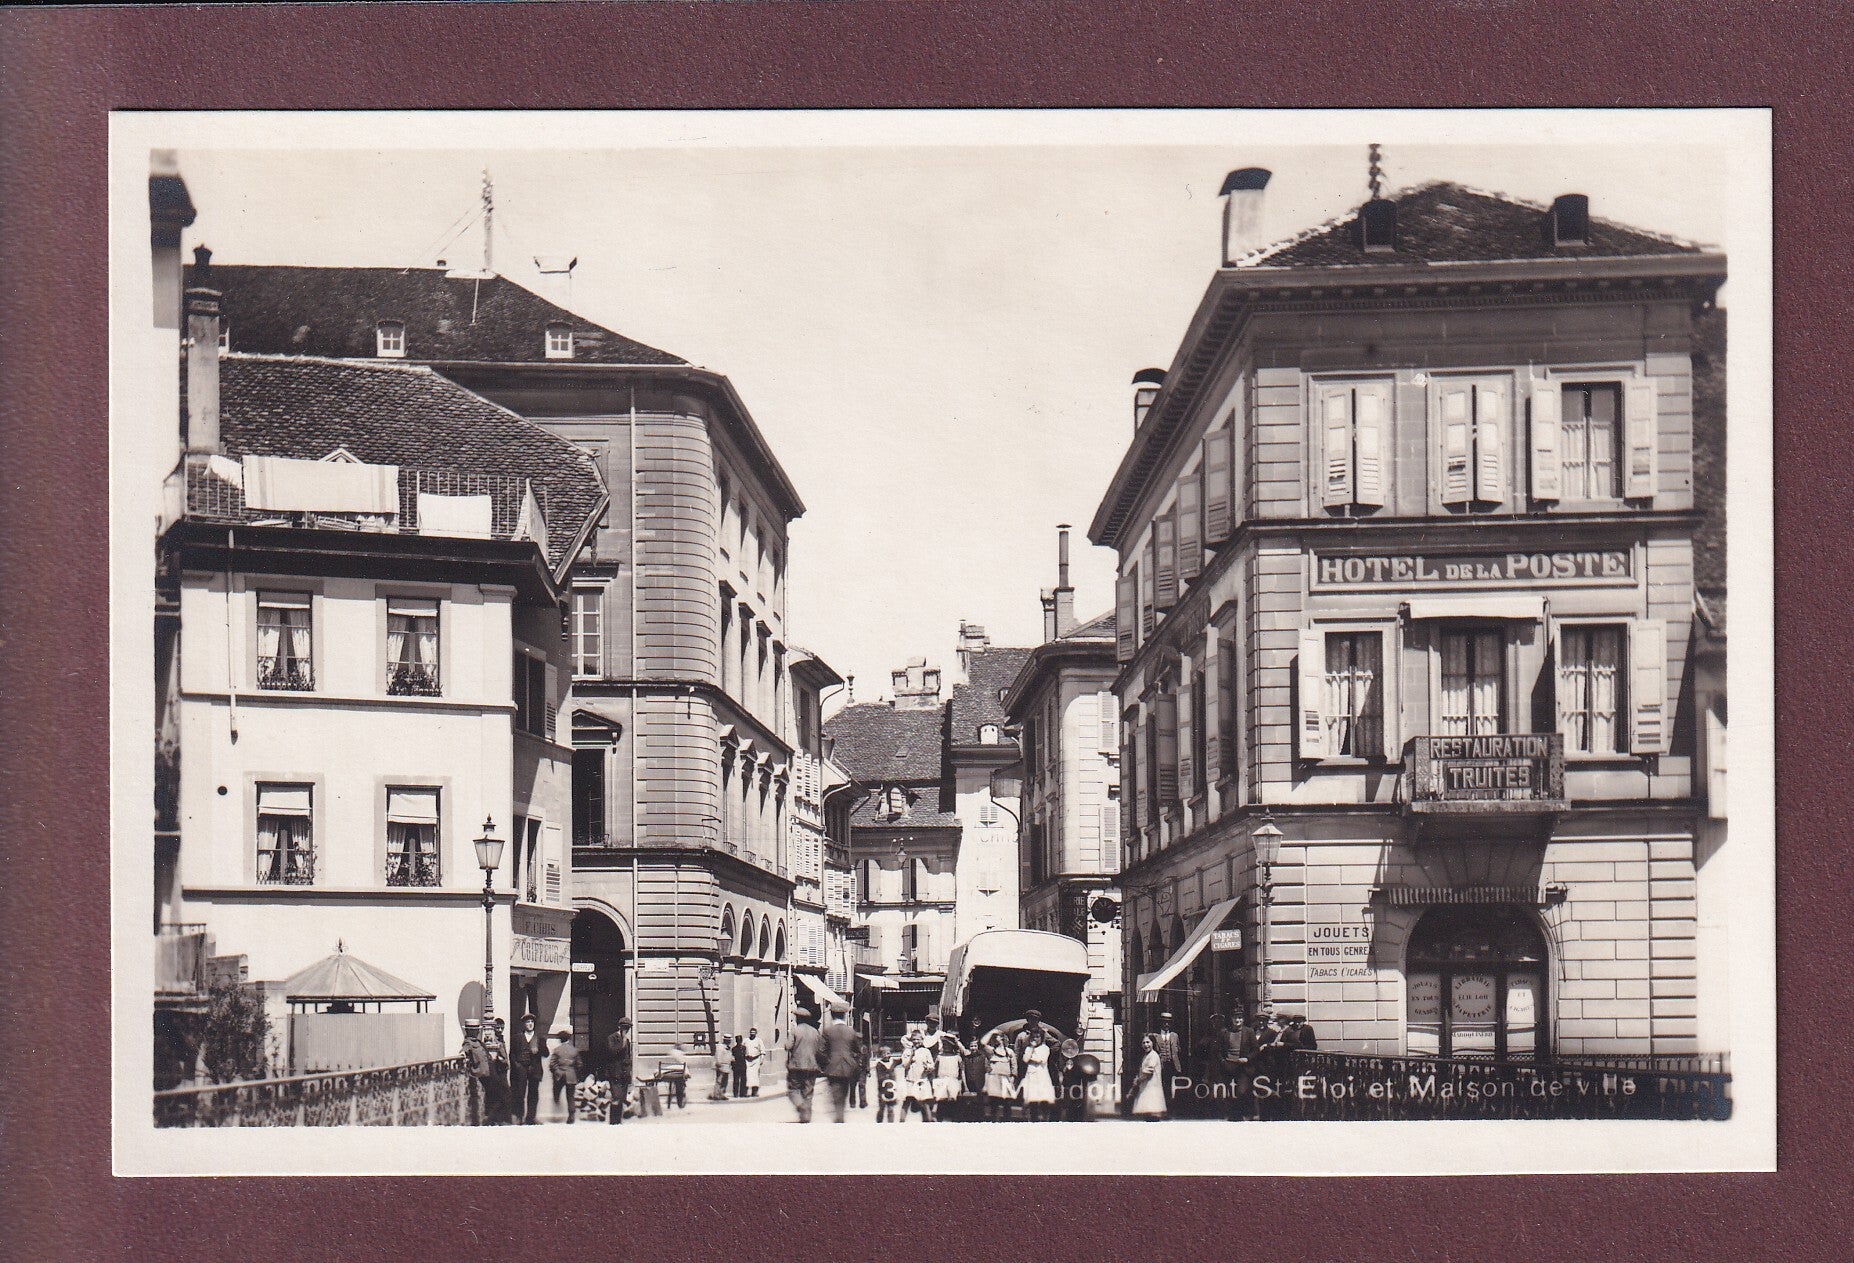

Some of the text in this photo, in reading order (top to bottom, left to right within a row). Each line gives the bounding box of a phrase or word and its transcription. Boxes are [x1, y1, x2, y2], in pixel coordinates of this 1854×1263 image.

[1321, 552, 1626, 583] HOTEL DE LA POSTE
[1430, 737, 1548, 758] RESTAURATION
[1450, 767, 1531, 788] TRUITES
[1313, 927, 1369, 938] JOUETS
[1308, 947, 1318, 957] EN
[1320, 947, 1340, 956] TOUS
[1310, 967, 1338, 978] TABACS
